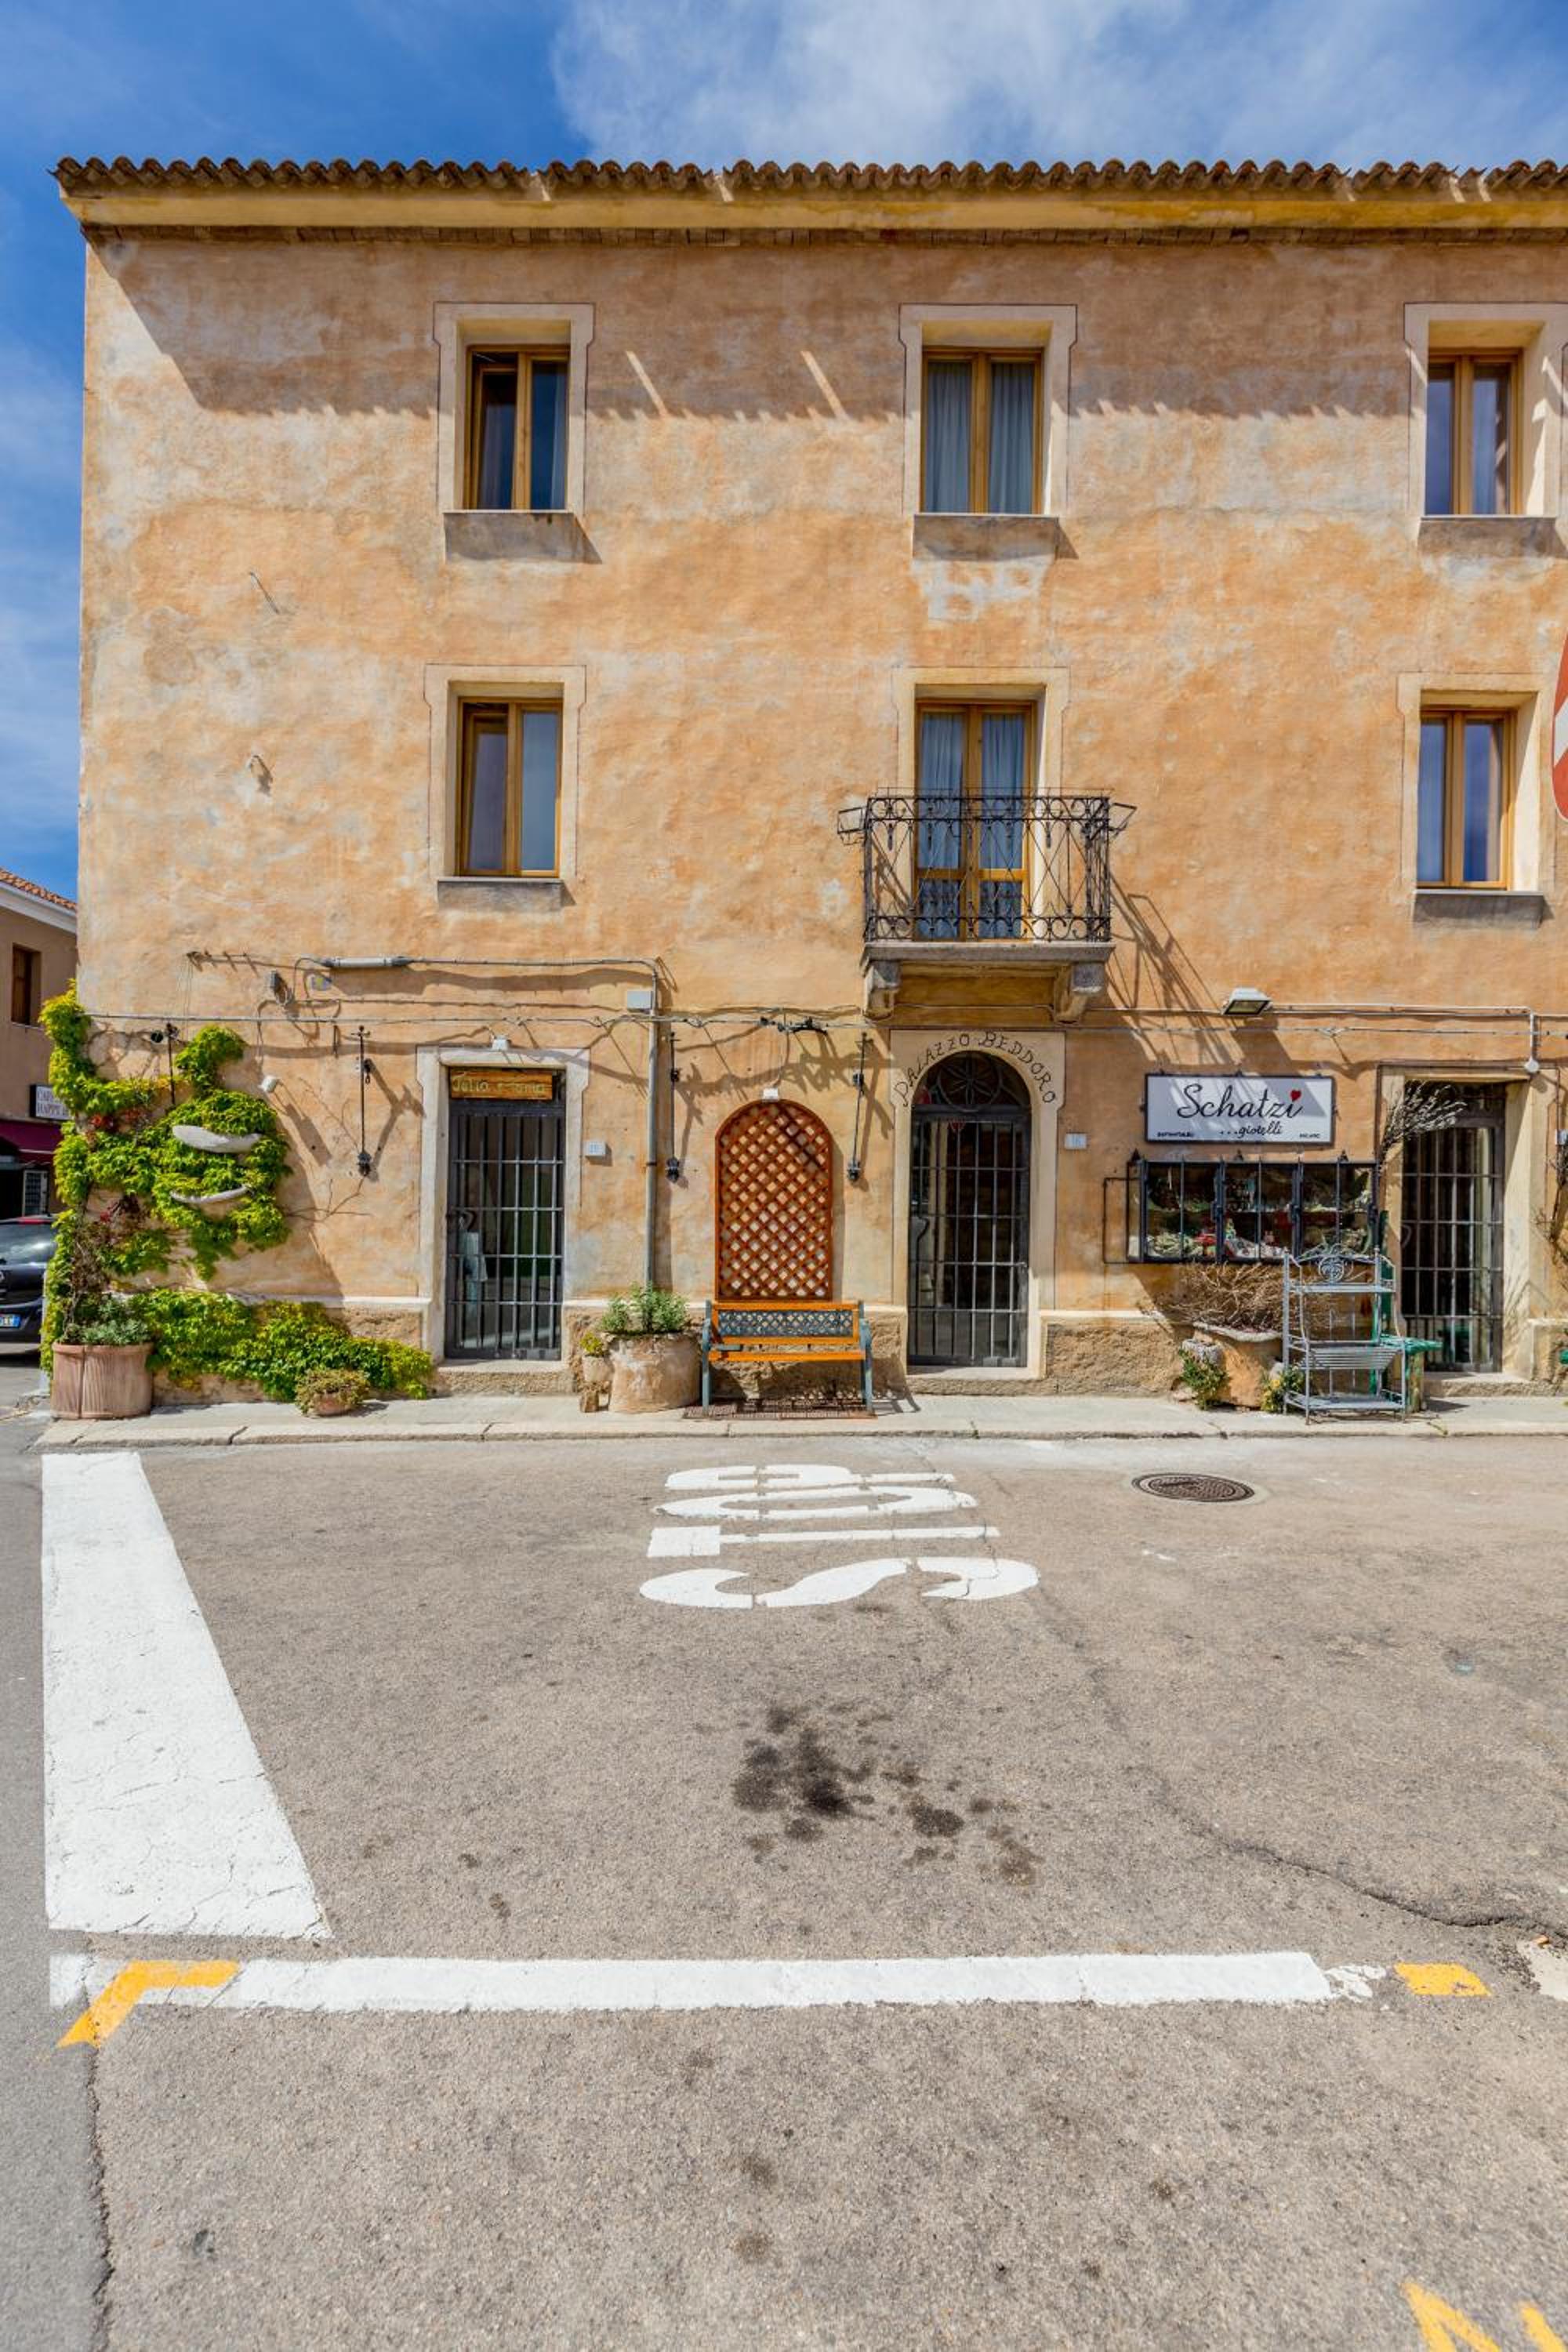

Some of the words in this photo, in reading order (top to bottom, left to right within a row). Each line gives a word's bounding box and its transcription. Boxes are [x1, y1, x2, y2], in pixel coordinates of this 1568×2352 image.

[894, 1033, 970, 1107] PALAZZO
[1176, 1083, 1304, 1119] Schatzi
[639, 1464, 1040, 1610] STOP
